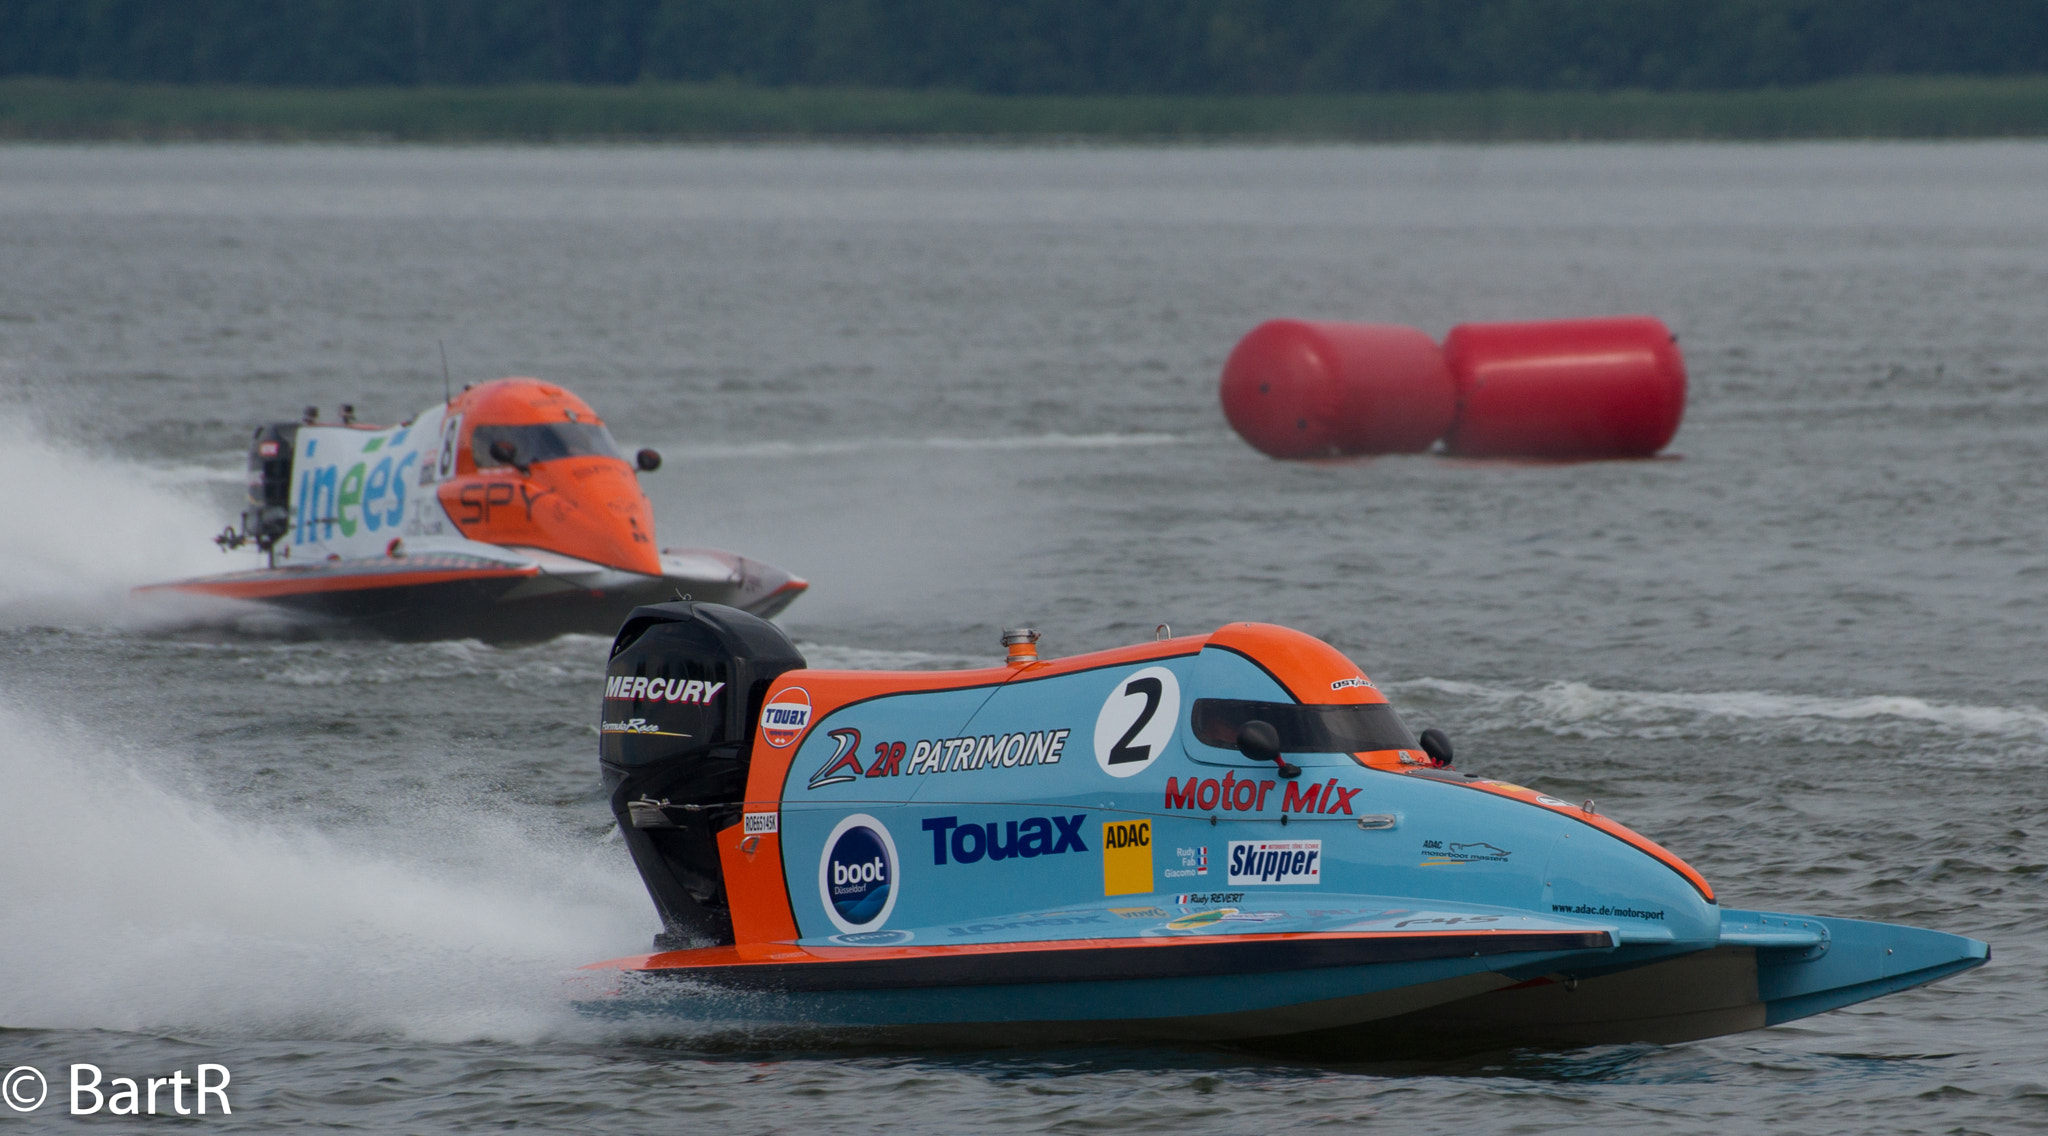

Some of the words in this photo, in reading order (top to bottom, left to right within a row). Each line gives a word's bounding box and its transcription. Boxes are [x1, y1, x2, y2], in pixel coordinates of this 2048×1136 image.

[460, 482, 556, 525] SPY
[604, 676, 726, 705] MERCURY
[1107, 676, 1163, 766] 2
[865, 741, 907, 778] 2R
[906, 728, 1071, 775] PATRIMOINE
[1164, 769, 1276, 812] Motor
[1281, 778, 1363, 815] Mix
[921, 814, 1089, 866] Touax
[1106, 823, 1150, 849] ADAC
[1422, 840, 1443, 849] ADAC
[1176, 848, 1196, 858] Rudy
[1182, 857, 1196, 866] Fab
[1470, 854, 1509, 863] masters
[833, 856, 885, 885] boot
[1164, 867, 1196, 878] Giacomo
[834, 883, 867, 895] Düsseldorf
[1190, 894, 1209, 905] Rudy
[1210, 892, 1244, 904] REVERT
[1551, 902, 1665, 920] www.adac.de/motorsport
